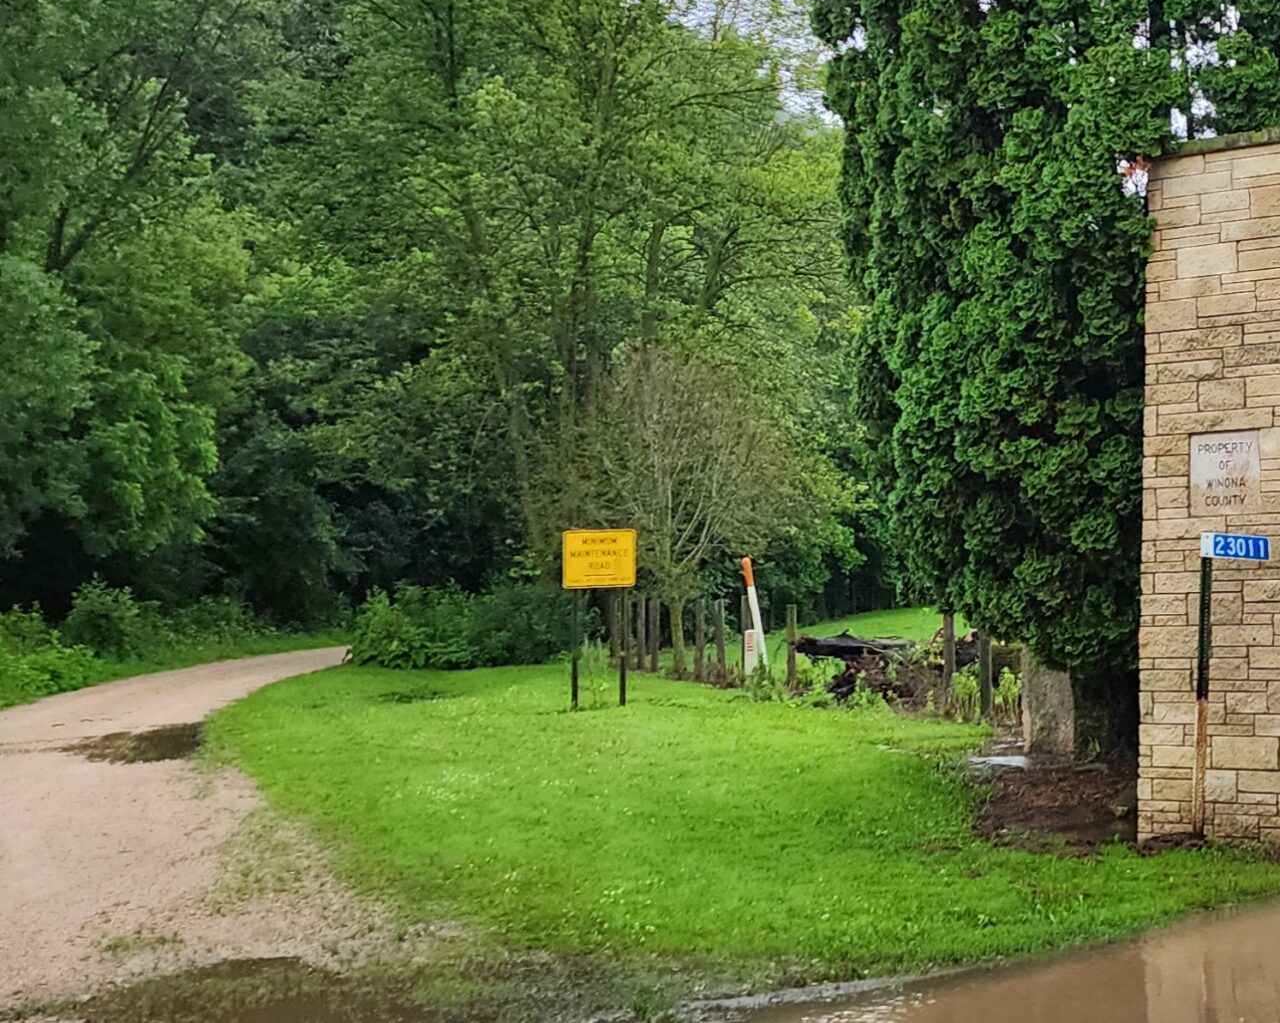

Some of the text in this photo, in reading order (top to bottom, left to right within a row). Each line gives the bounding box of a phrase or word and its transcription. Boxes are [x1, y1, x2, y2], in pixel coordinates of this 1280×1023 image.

[1197, 440, 1253, 455] PROPERTY
[1219, 459, 1233, 471] OF
[1205, 477, 1247, 490] WINONA
[1205, 494, 1247, 507] COUNTY
[582, 537, 618, 545] MINIMUM
[1215, 536, 1265, 558] 23011
[570, 548, 629, 558] MAINTENANCE
[588, 562, 611, 570] ROAD
